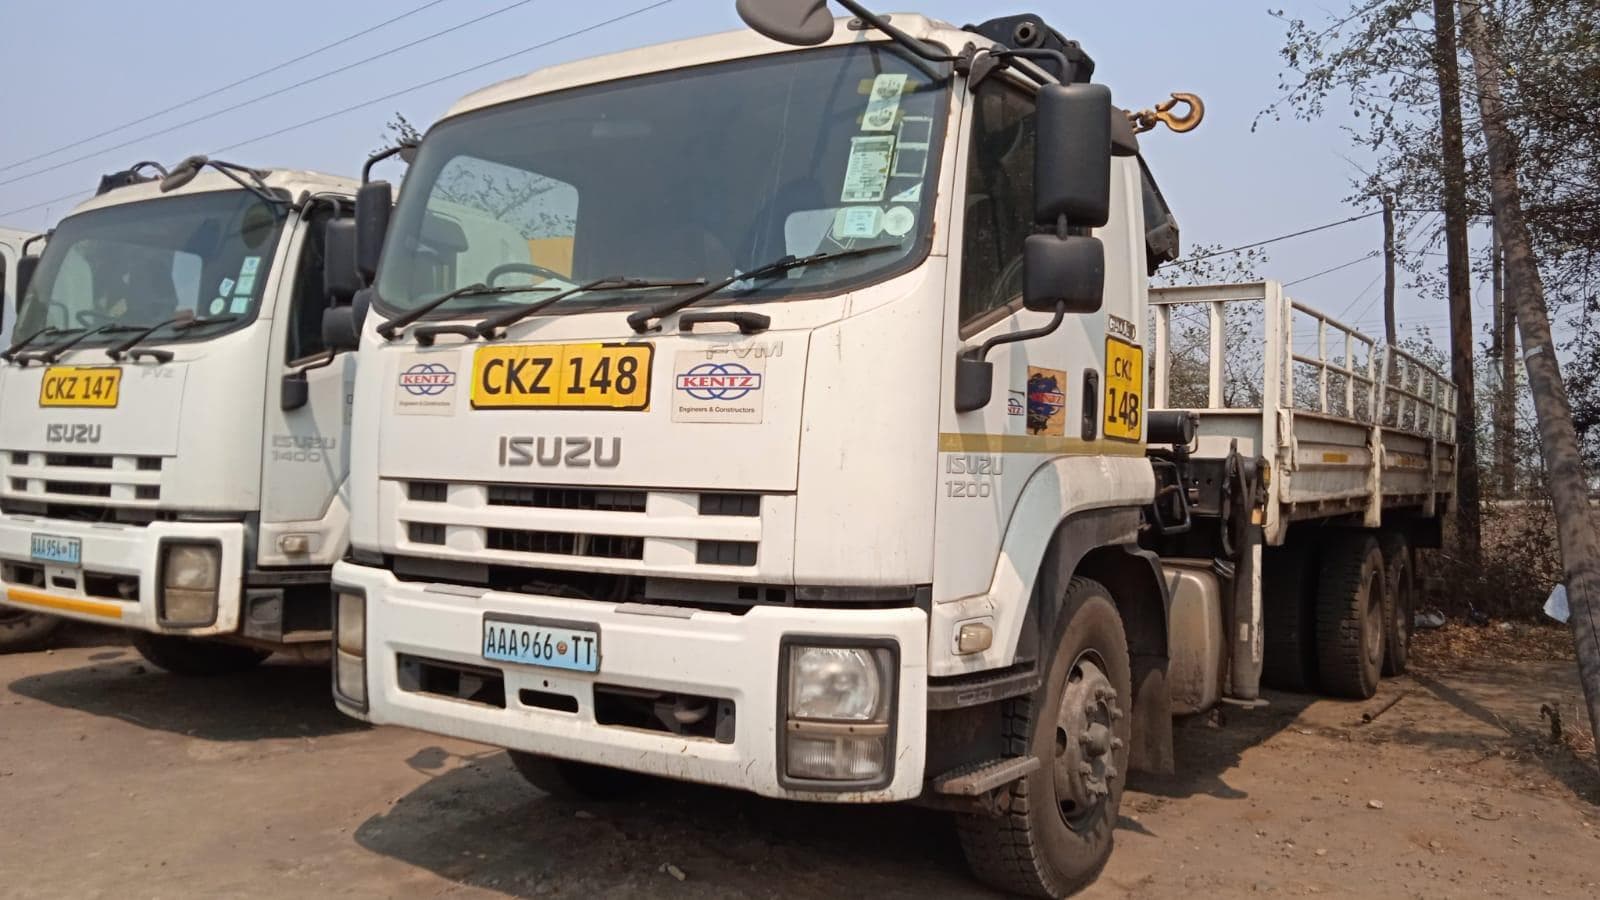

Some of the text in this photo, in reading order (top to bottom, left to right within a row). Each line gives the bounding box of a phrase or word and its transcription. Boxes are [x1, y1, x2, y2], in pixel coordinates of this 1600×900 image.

[403, 375, 450, 384] KENTZ
[482, 356, 638, 395] CKZ 148
[683, 376, 754, 387] KENTZ
[45, 376, 115, 400] CKZ 147
[1108, 388, 1139, 430] 148
[46, 423, 101, 443] ISUZU
[271, 435, 336, 449] ISUZU
[272, 450, 320, 462] 1400
[498, 436, 622, 467] ISUZU
[945, 454, 1004, 476] ISUZU
[944, 480, 991, 498] 1200
[487, 627, 594, 665] AAA966 TT
